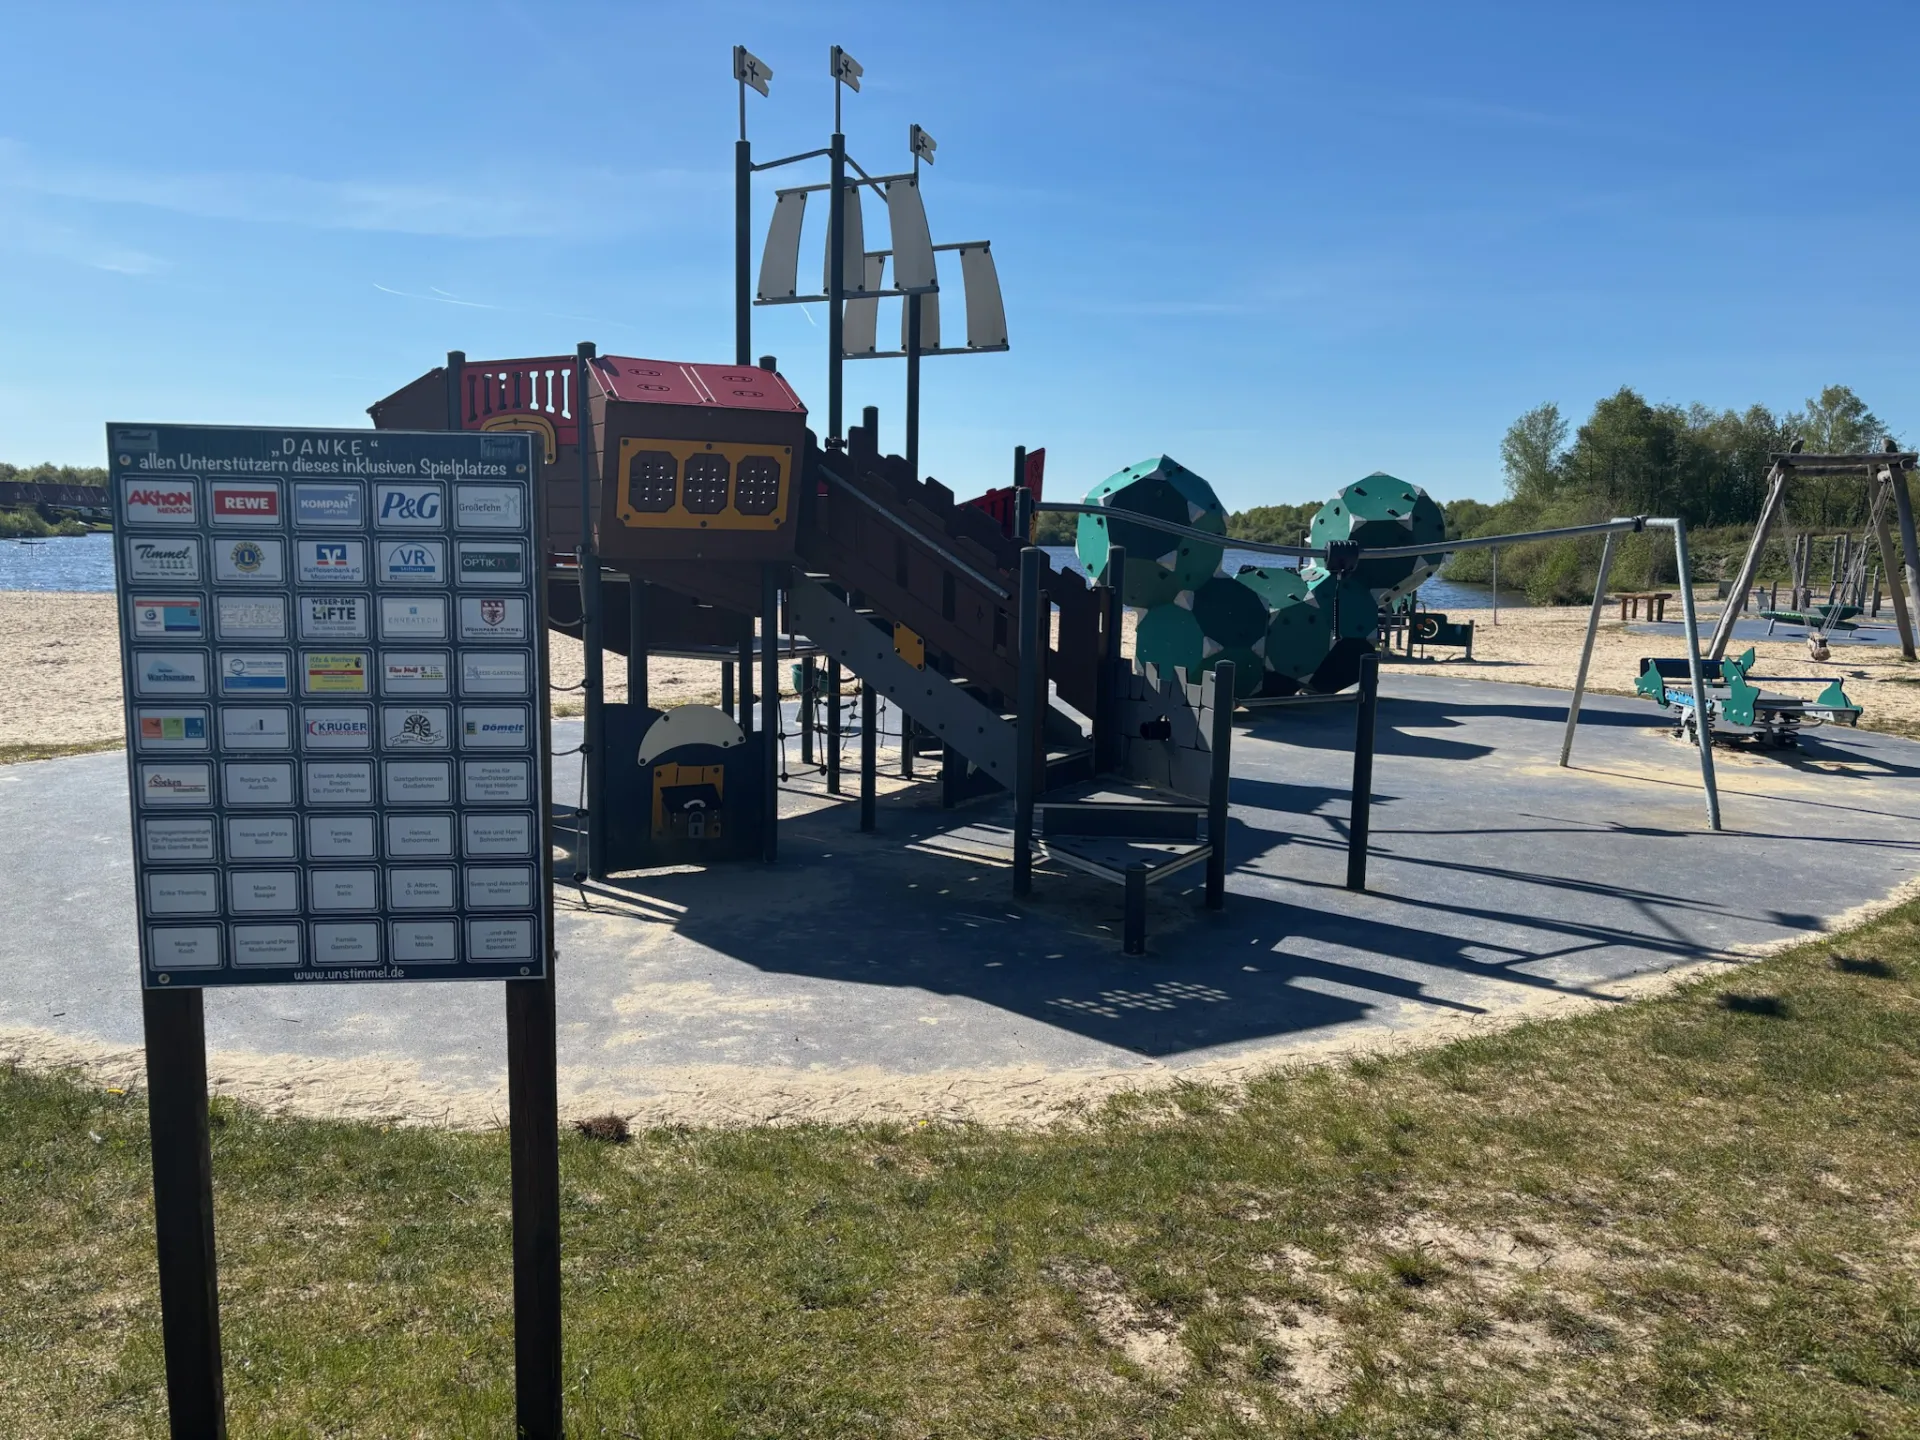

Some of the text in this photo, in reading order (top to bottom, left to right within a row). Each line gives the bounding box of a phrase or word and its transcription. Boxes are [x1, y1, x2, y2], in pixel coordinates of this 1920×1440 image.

[138, 453, 507, 480] allen Unterstützern dieses inklusiven Spielplatzes
[225, 496, 270, 510] REWE
[301, 499, 349, 509] KOMPAN
[380, 492, 440, 520] P&G
[157, 507, 193, 515] MENSCH
[134, 543, 191, 560] Timmel
[399, 550, 426, 565] VR
[463, 558, 496, 567] OPTIK
[311, 598, 356, 606] WESER-EMS
[294, 965, 405, 980] www.unstimmel.de
